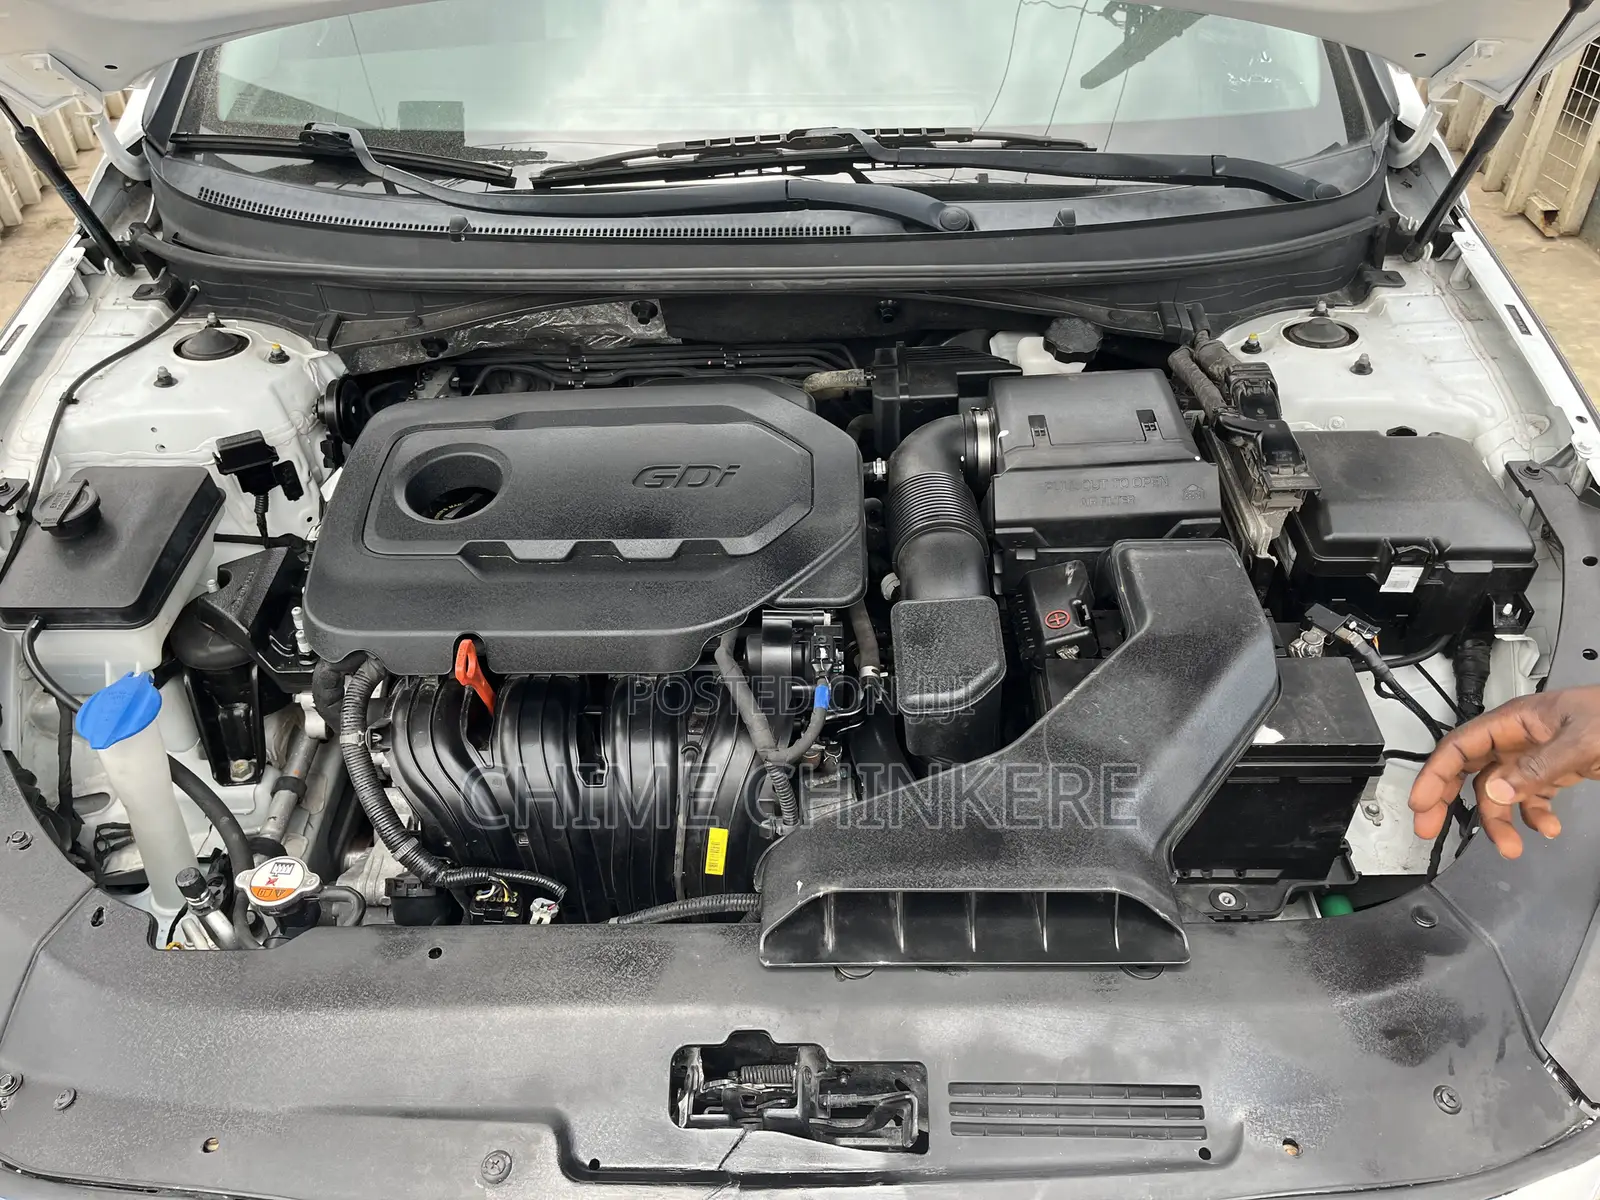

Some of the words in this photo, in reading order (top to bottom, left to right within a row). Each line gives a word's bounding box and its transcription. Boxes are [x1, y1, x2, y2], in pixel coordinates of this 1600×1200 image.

[632, 463, 741, 489] GDi
[1081, 478, 1109, 492] OUT
[1132, 475, 1170, 489] OPEN
